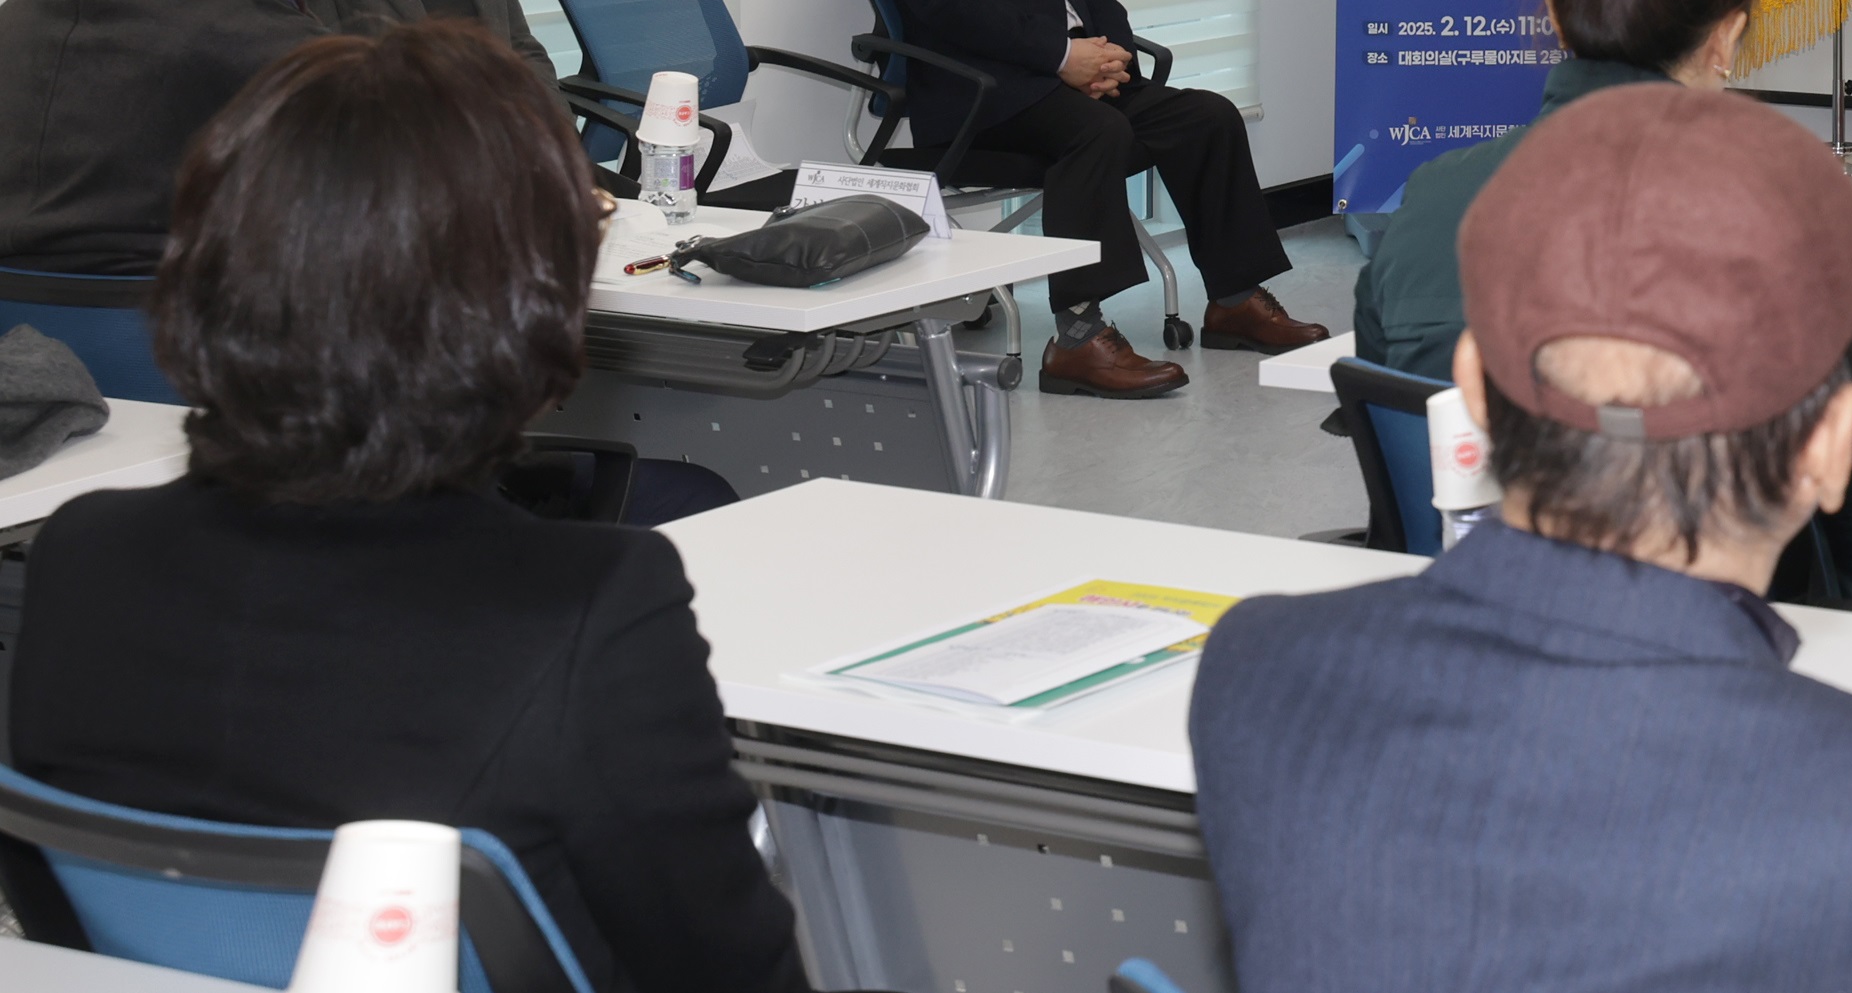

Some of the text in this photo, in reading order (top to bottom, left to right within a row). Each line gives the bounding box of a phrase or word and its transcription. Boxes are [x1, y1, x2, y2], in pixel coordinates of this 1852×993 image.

[1367, 23, 1388, 34] 일시
[1398, 22, 1436, 35] 2025.
[1518, 16, 1554, 35] 11:0
[1367, 53, 1388, 65] 장소
[1389, 124, 1431, 145] WJCA
